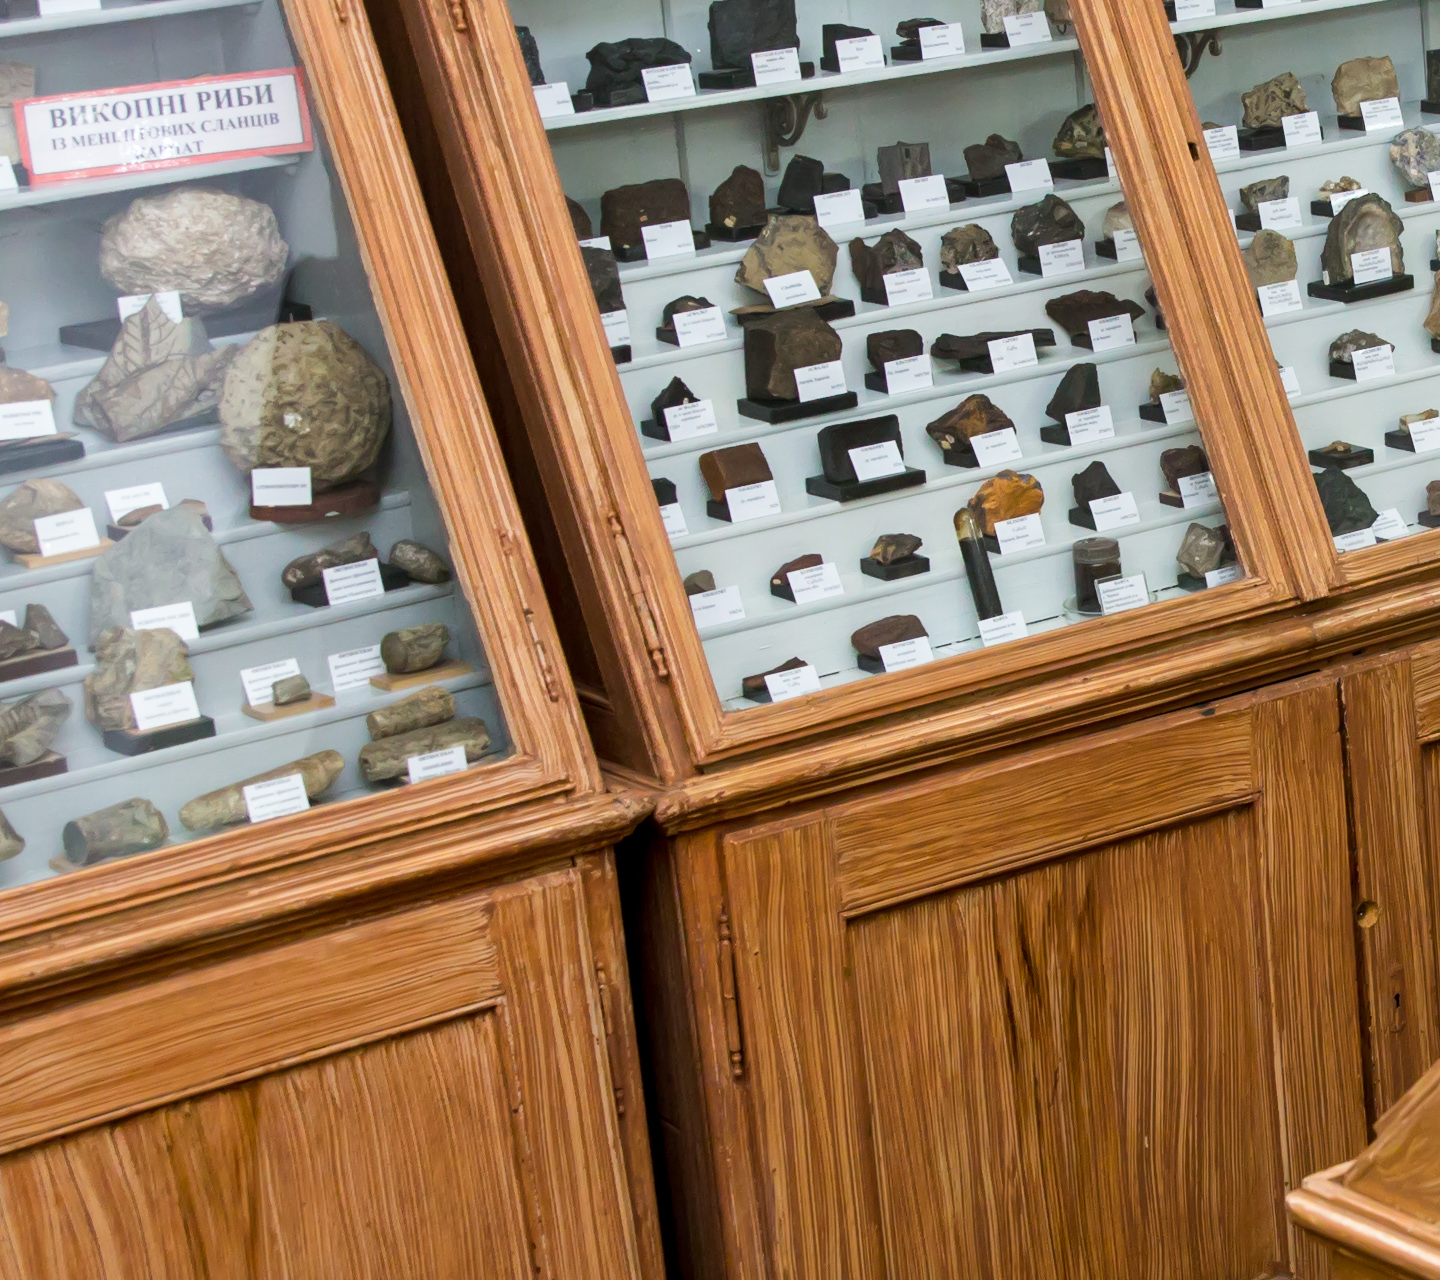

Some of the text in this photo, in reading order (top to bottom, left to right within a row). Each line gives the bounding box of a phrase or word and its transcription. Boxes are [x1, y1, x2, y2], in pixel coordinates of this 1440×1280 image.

[50, 83, 275, 129] ВИКОПНІ РИБИ
[201, 112, 280, 133] СЛАНЦІВ
